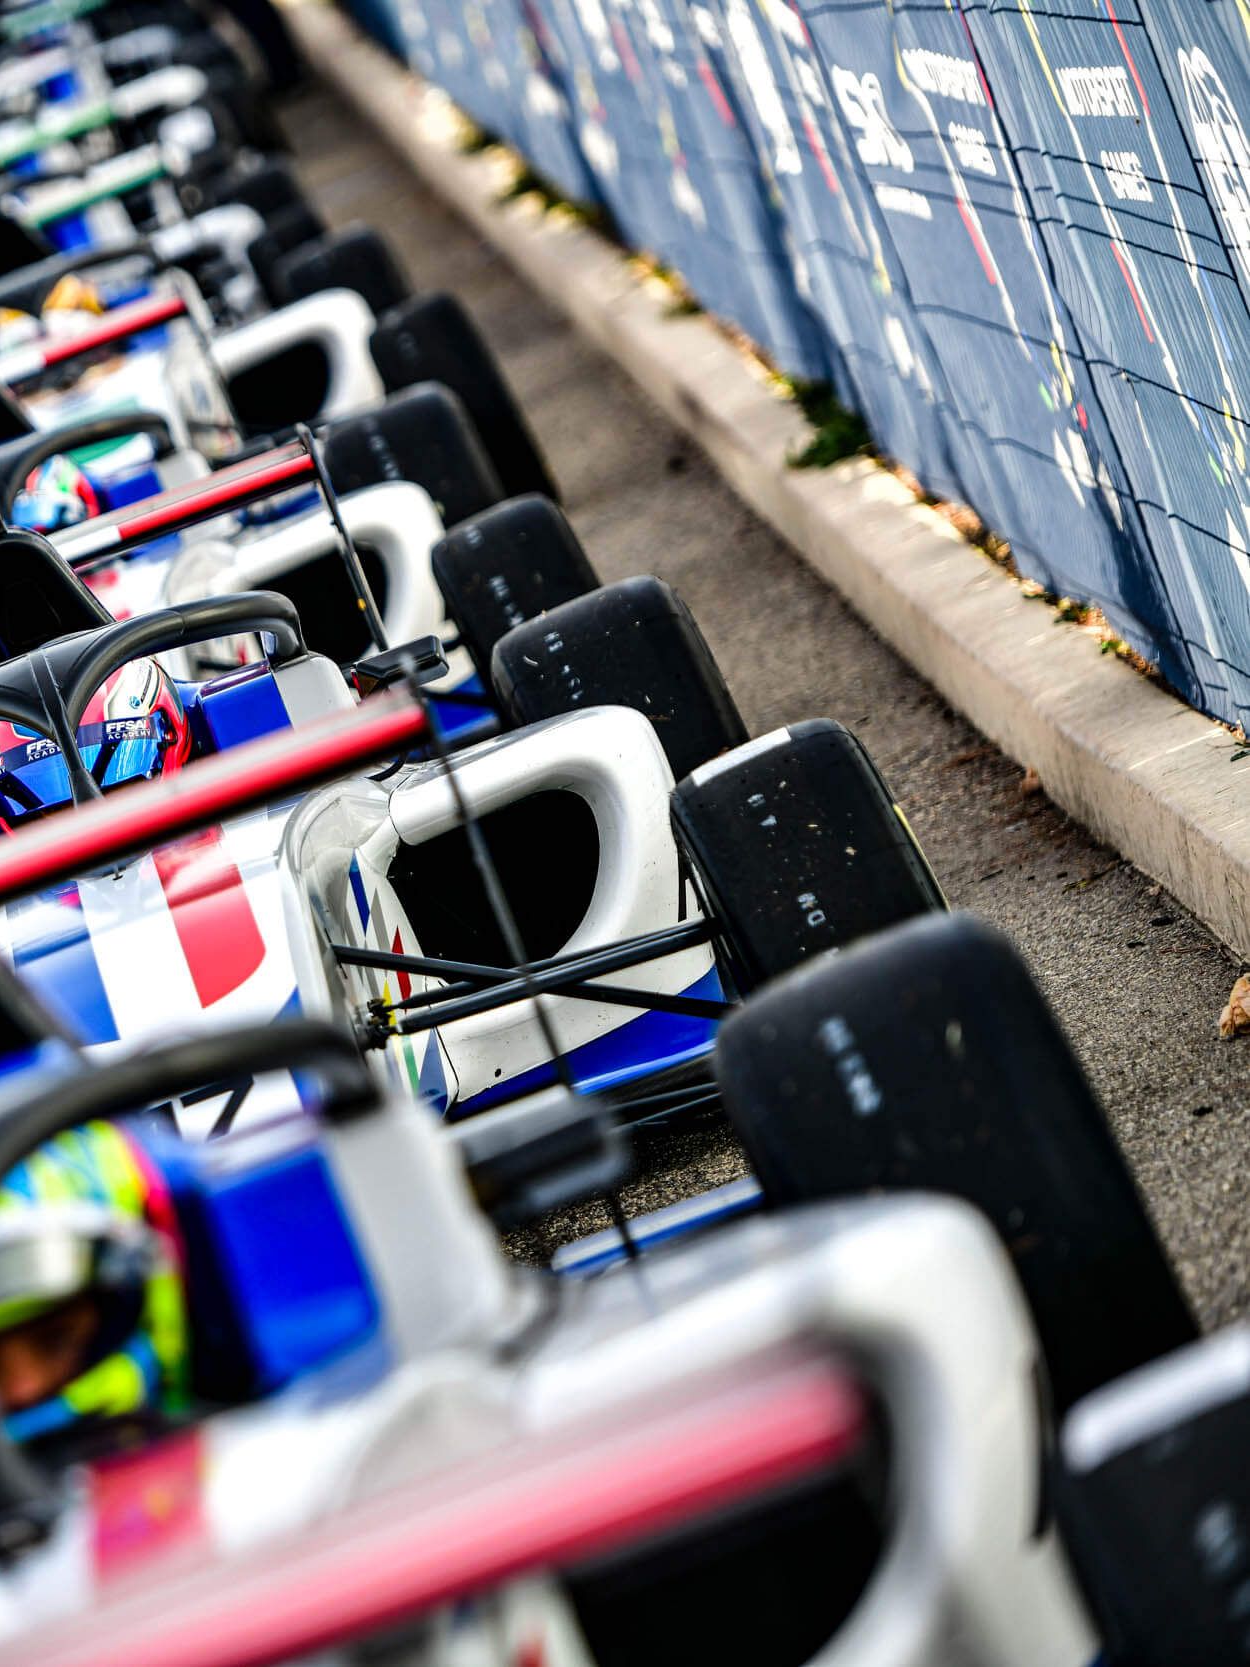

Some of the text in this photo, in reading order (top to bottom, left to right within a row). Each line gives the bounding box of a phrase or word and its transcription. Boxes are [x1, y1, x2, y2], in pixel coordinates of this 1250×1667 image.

[1055, 66, 1139, 116] MOTORSPORT
[1100, 150, 1154, 202] GAMES
[108, 729, 150, 740] ACADEMY
[27, 739, 56, 757] FFS
[29, 747, 61, 761] ACADE
